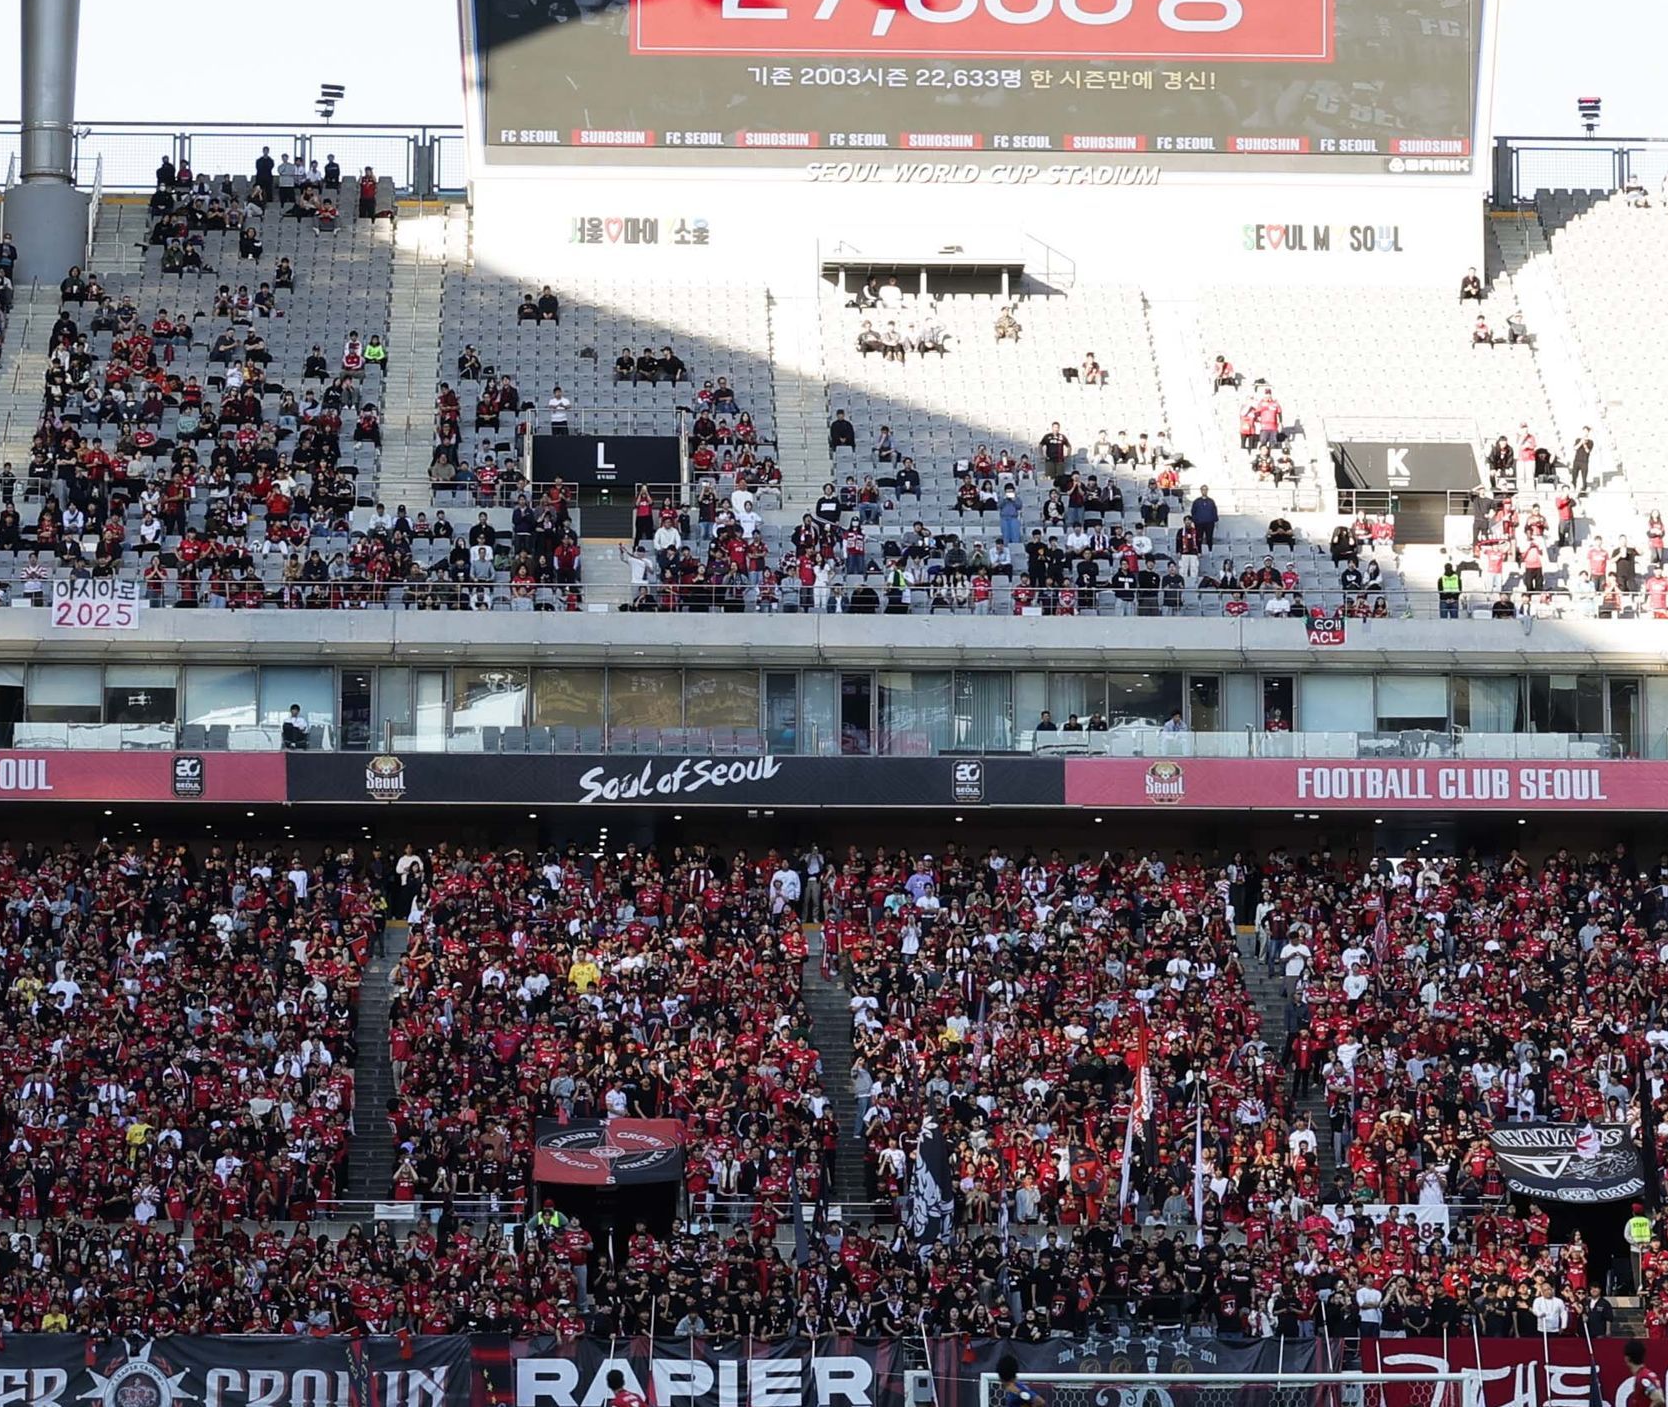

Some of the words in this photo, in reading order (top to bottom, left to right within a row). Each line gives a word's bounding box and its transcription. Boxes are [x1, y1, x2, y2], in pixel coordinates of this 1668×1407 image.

[747, 66, 794, 86] 기존
[800, 67, 909, 87] 2003시즌
[915, 68, 1022, 88] 22,633명
[1030, 69, 1054, 89] 한
[1060, 70, 1153, 90] 시즌만에
[1162, 71, 1216, 91] 경신!
[501, 129, 517, 143] FC
[520, 129, 561, 143] SEOUL
[580, 130, 645, 145] SUHOSHIN
[665, 131, 682, 145] FC
[684, 131, 725, 145] SEOUL
[745, 132, 810, 146] SUHOSHIN
[829, 132, 846, 147] FC
[849, 132, 889, 147] SEOUL
[908, 133, 974, 148] SUHOSHIN
[993, 134, 1010, 148] FC
[1012, 134, 1052, 148] SEOUL
[1073, 135, 1137, 150] SUHOSHIN
[1157, 136, 1173, 150] FC
[1176, 136, 1216, 150] SEOUL
[1236, 137, 1300, 151] SUHOSHIN
[1320, 138, 1336, 152] FC
[1338, 138, 1379, 152] SEOUL
[1399, 138, 1462, 153] SUHOSHIN
[804, 163, 883, 183] SEOUL
[894, 164, 982, 184] WORLD
[988, 165, 1041, 185] CUP
[1050, 165, 1162, 186] STADIUM
[597, 442, 616, 469] L
[1387, 448, 1411, 476] K
[56, 579, 136, 600] 아시아로
[56, 602, 134, 626] 2025
[1309, 631, 1340, 643] ACL
[366, 768, 405, 789] Seoul
[579, 766, 656, 803] Soul
[657, 763, 692, 793] of
[684, 755, 782, 789] Seoul
[1144, 772, 1185, 794] Seoul
[1297, 767, 1433, 800] FOOTBALL
[1438, 768, 1510, 800] CLUB
[1520, 768, 1608, 801] SEOUL
[515, 1357, 874, 1407] RAPIER
